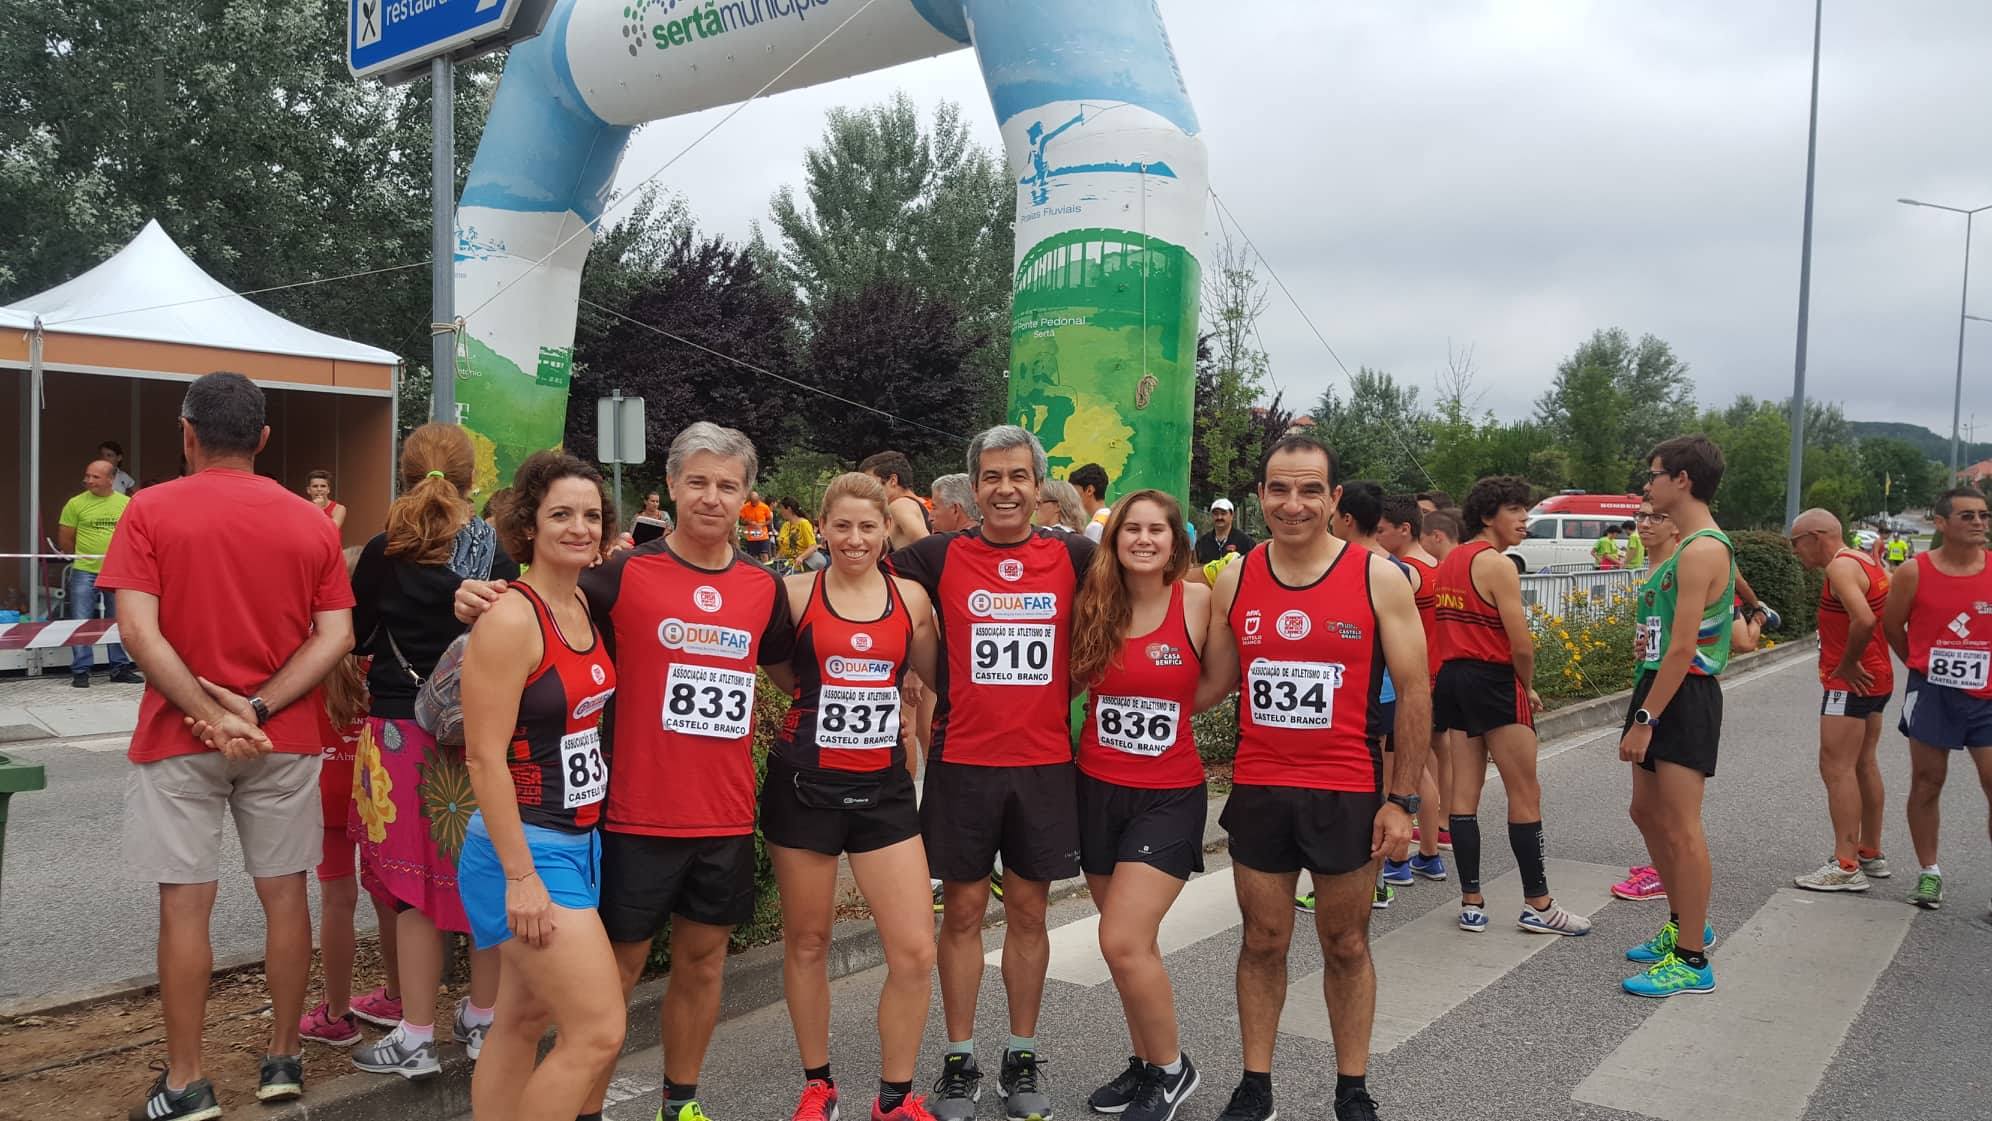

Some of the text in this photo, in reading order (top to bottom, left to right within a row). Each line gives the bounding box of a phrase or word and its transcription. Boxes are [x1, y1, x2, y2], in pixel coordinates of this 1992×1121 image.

[1043, 204, 1082, 217] Fluviais
[1041, 316, 1086, 327] Pedonal
[993, 596, 1052, 610] DUAFAR
[686, 627, 748, 650] DUAFAR
[975, 626, 1052, 639] ASSOCIAÇÃO DE ATLETISMO DE
[975, 640, 1048, 670] 910
[846, 662, 889, 673] DUAFAR
[1282, 667, 1289, 677] DE
[1291, 667, 1320, 679] ATLETISMO
[1322, 670, 1330, 680] DE
[1932, 658, 1981, 680] 851
[672, 667, 707, 683] ASSOCIAÇÃO
[709, 672, 717, 683] DE
[719, 673, 745, 687] ATLETISMO
[975, 672, 1049, 681] CASTELO BRANCO
[824, 689, 856, 702] ASSOCIAÇÃO
[858, 691, 865, 701] DE
[1253, 679, 1327, 714] 834
[669, 683, 748, 722] 833
[1132, 699, 1139, 709] DE
[1140, 700, 1167, 711] ATLETISMO
[1169, 703, 1176, 712] DE
[822, 703, 896, 733] 837
[1101, 708, 1172, 741] 836
[1254, 712, 1328, 725] CASTELO BRANCO
[666, 718, 746, 735] CASTELO BRANCO
[820, 735, 894, 745] CASTELO BRANCO
[1101, 736, 1133, 749] CASTELO
[568, 748, 605, 788] 83
